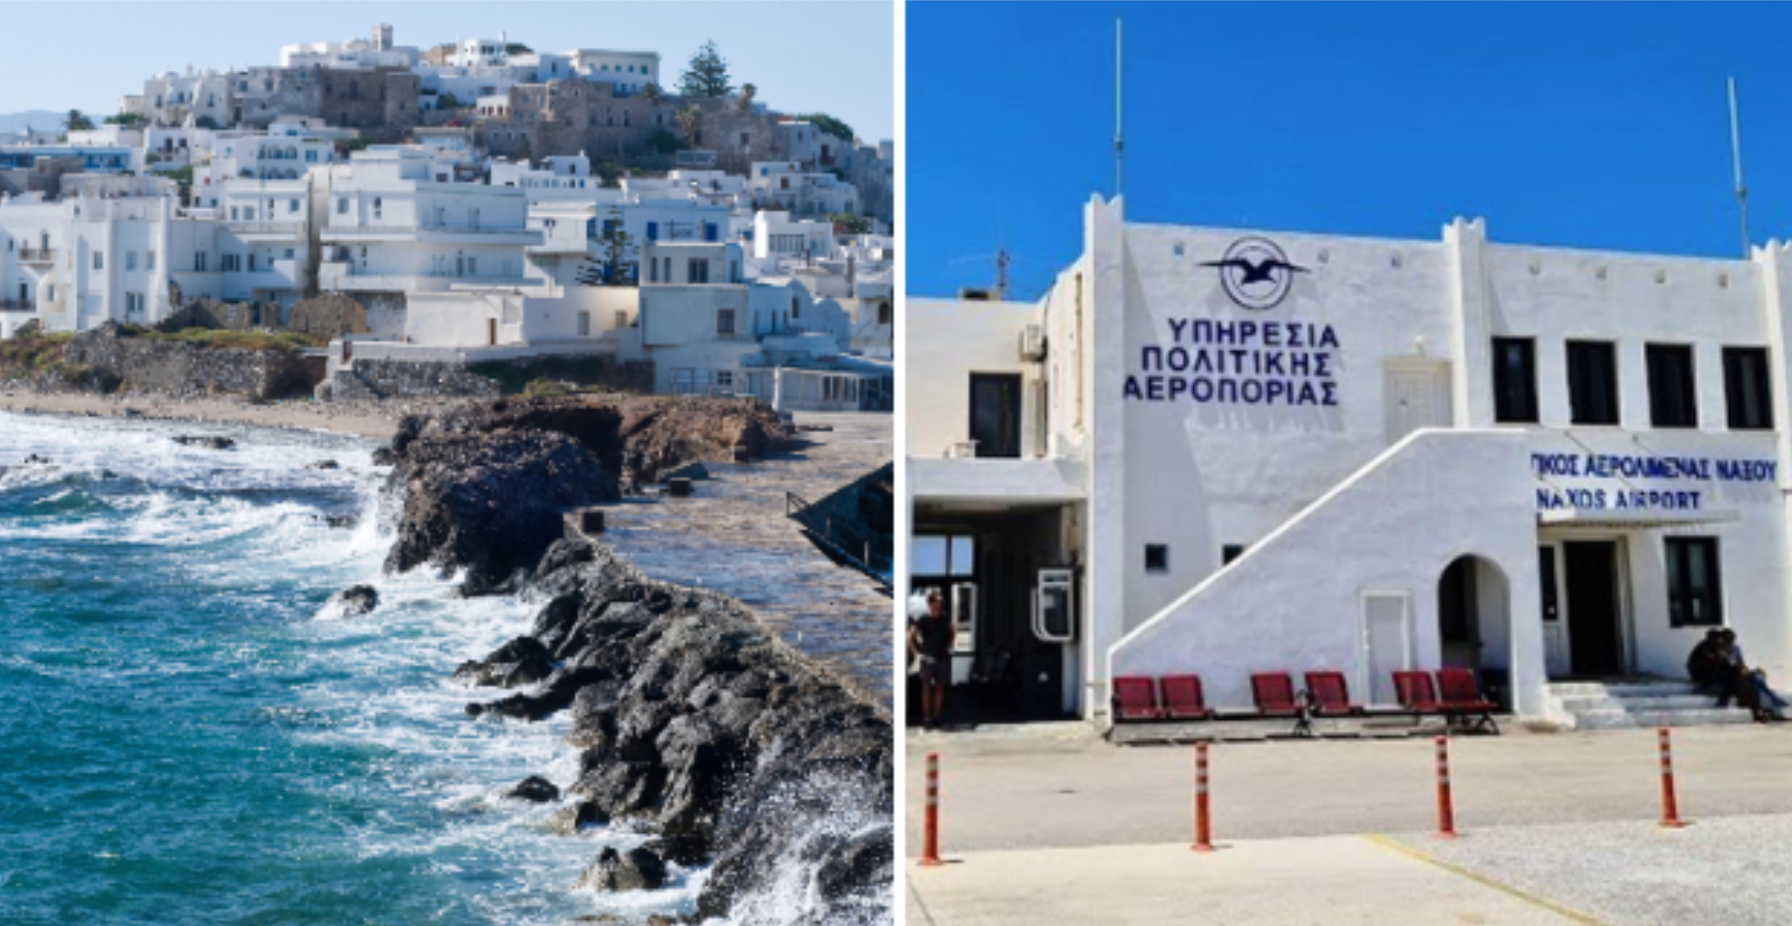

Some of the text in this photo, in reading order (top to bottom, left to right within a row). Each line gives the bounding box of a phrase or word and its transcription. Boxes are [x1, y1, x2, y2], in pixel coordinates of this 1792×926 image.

[1168, 317, 1340, 349] ΥΠΗΡΕΣΙΑ
[1142, 346, 1332, 377] ΠΟΛΙΤΙΚΗΣ
[1123, 375, 1338, 406] ΑΕΡΟΠΟΡΙΑΣ
[1536, 488, 1702, 510] NAXOS AIRPORT
